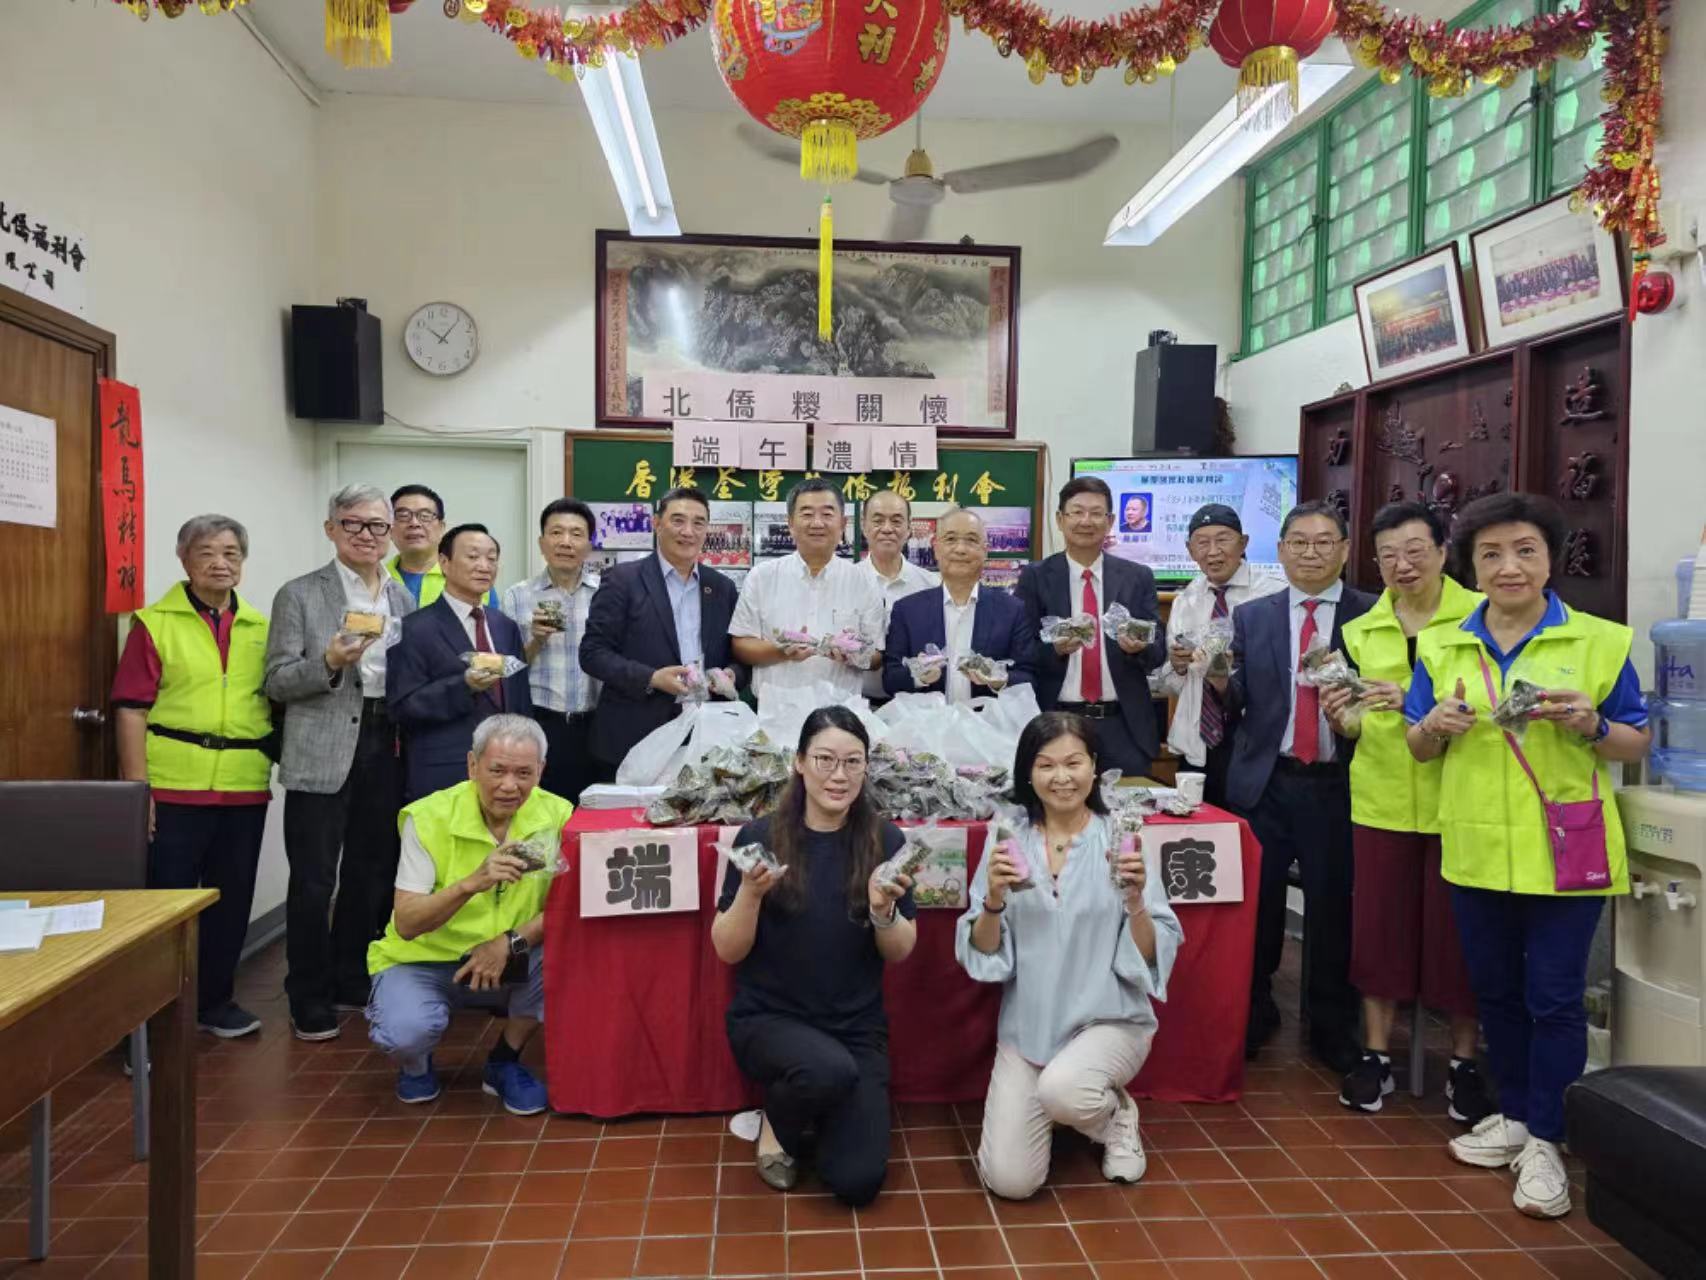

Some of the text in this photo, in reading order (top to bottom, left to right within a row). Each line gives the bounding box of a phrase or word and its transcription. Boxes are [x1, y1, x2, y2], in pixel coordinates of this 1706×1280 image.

[625, 459, 1006, 505] 香港荃灣僑福利會
[691, 435, 918, 471] 端午濃情
[110, 401, 141, 592] 龍馬精神
[605, 842, 672, 910] 端
[1160, 837, 1218, 900] 康
